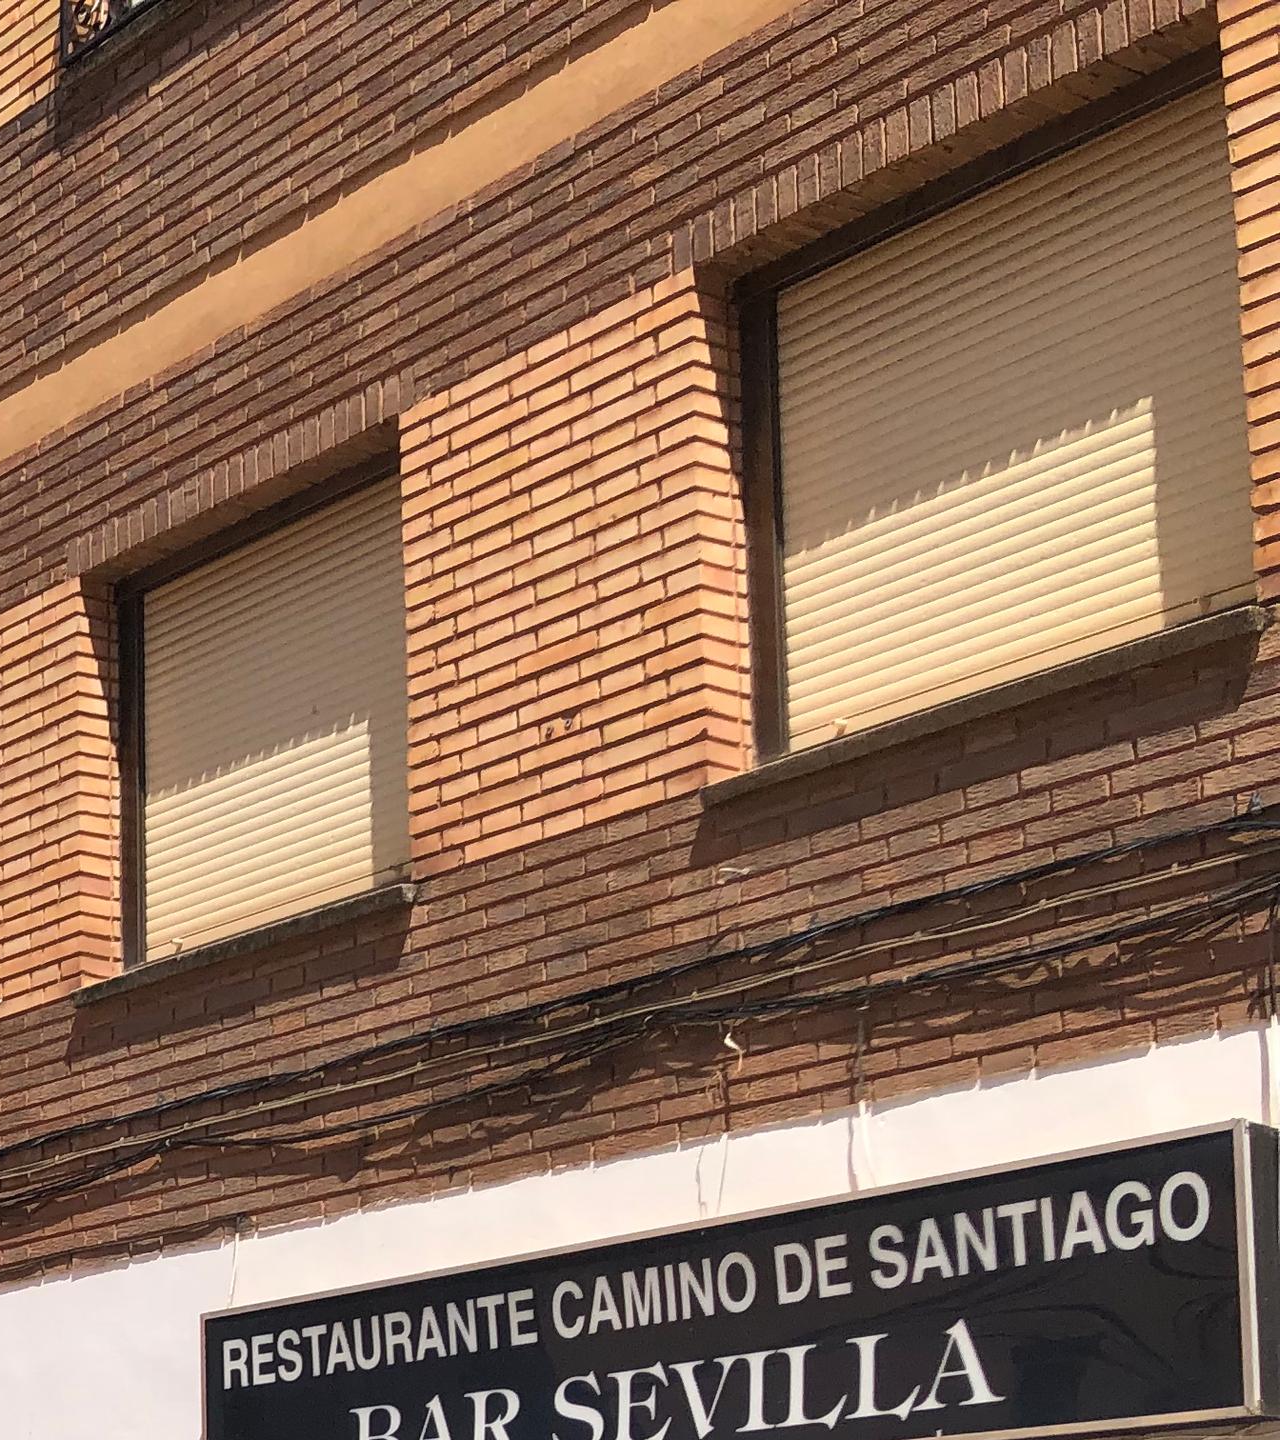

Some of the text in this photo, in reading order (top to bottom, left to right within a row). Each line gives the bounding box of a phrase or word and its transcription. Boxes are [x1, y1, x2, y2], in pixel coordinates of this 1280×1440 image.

[222, 1171, 1210, 1390] RESTAURANTE CAMINO DE SANTIAGO
